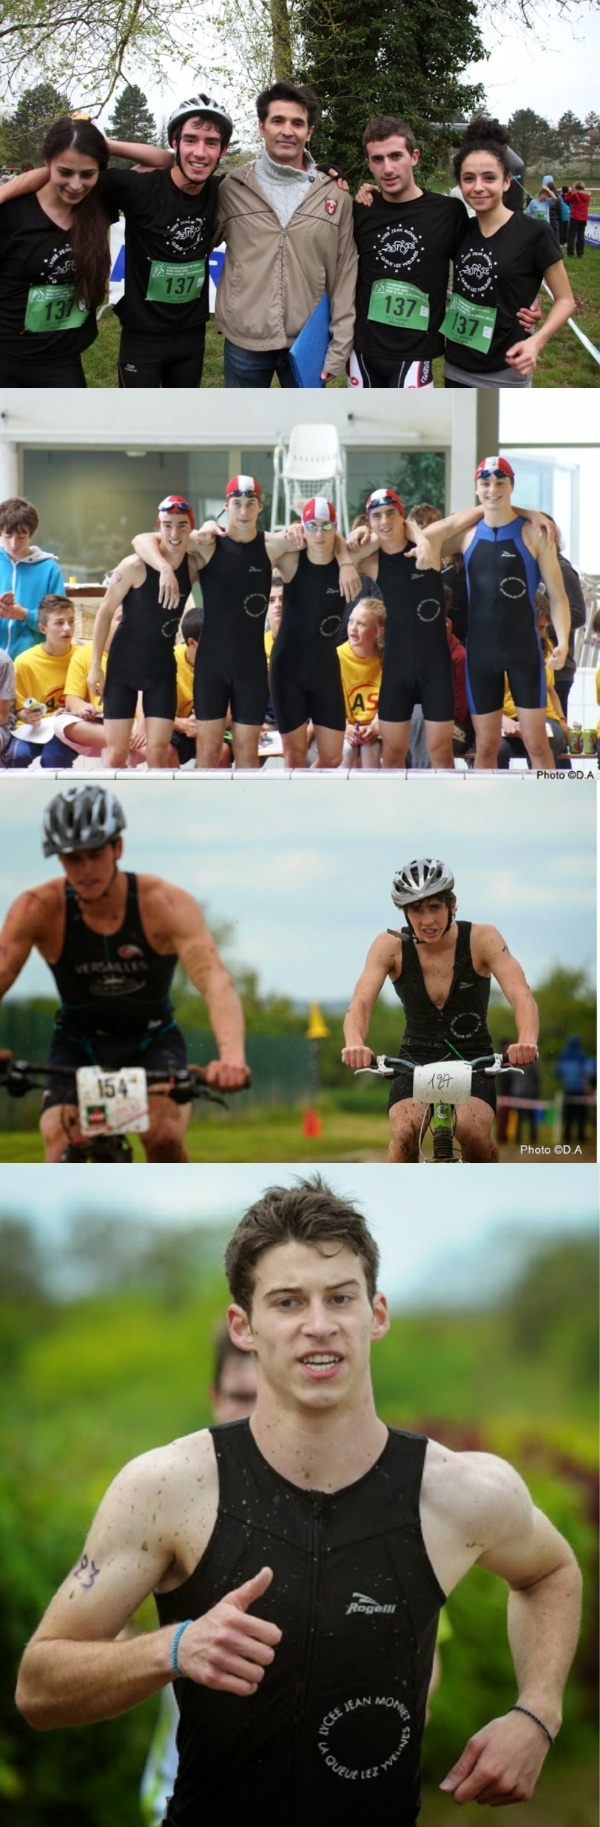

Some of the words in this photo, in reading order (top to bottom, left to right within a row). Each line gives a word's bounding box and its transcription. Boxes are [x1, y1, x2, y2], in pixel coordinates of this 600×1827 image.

[165, 276, 196, 295] 137
[45, 297, 75, 321] 137
[385, 295, 417, 318] 137
[451, 312, 480, 337] 137
[352, 693, 379, 712] AS
[97, 1078, 128, 1099] 154
[345, 1601, 397, 1616] Rogelli
[318, 1707, 344, 1736] LYCEE
[343, 1696, 372, 1713] JEAN
[374, 1696, 412, 1723] MONNET
[318, 1741, 330, 1755] LA
[325, 1754, 359, 1780] QUEUE
[360, 1766, 380, 1780] LEZ
[380, 1726, 411, 1771] YVELINES
